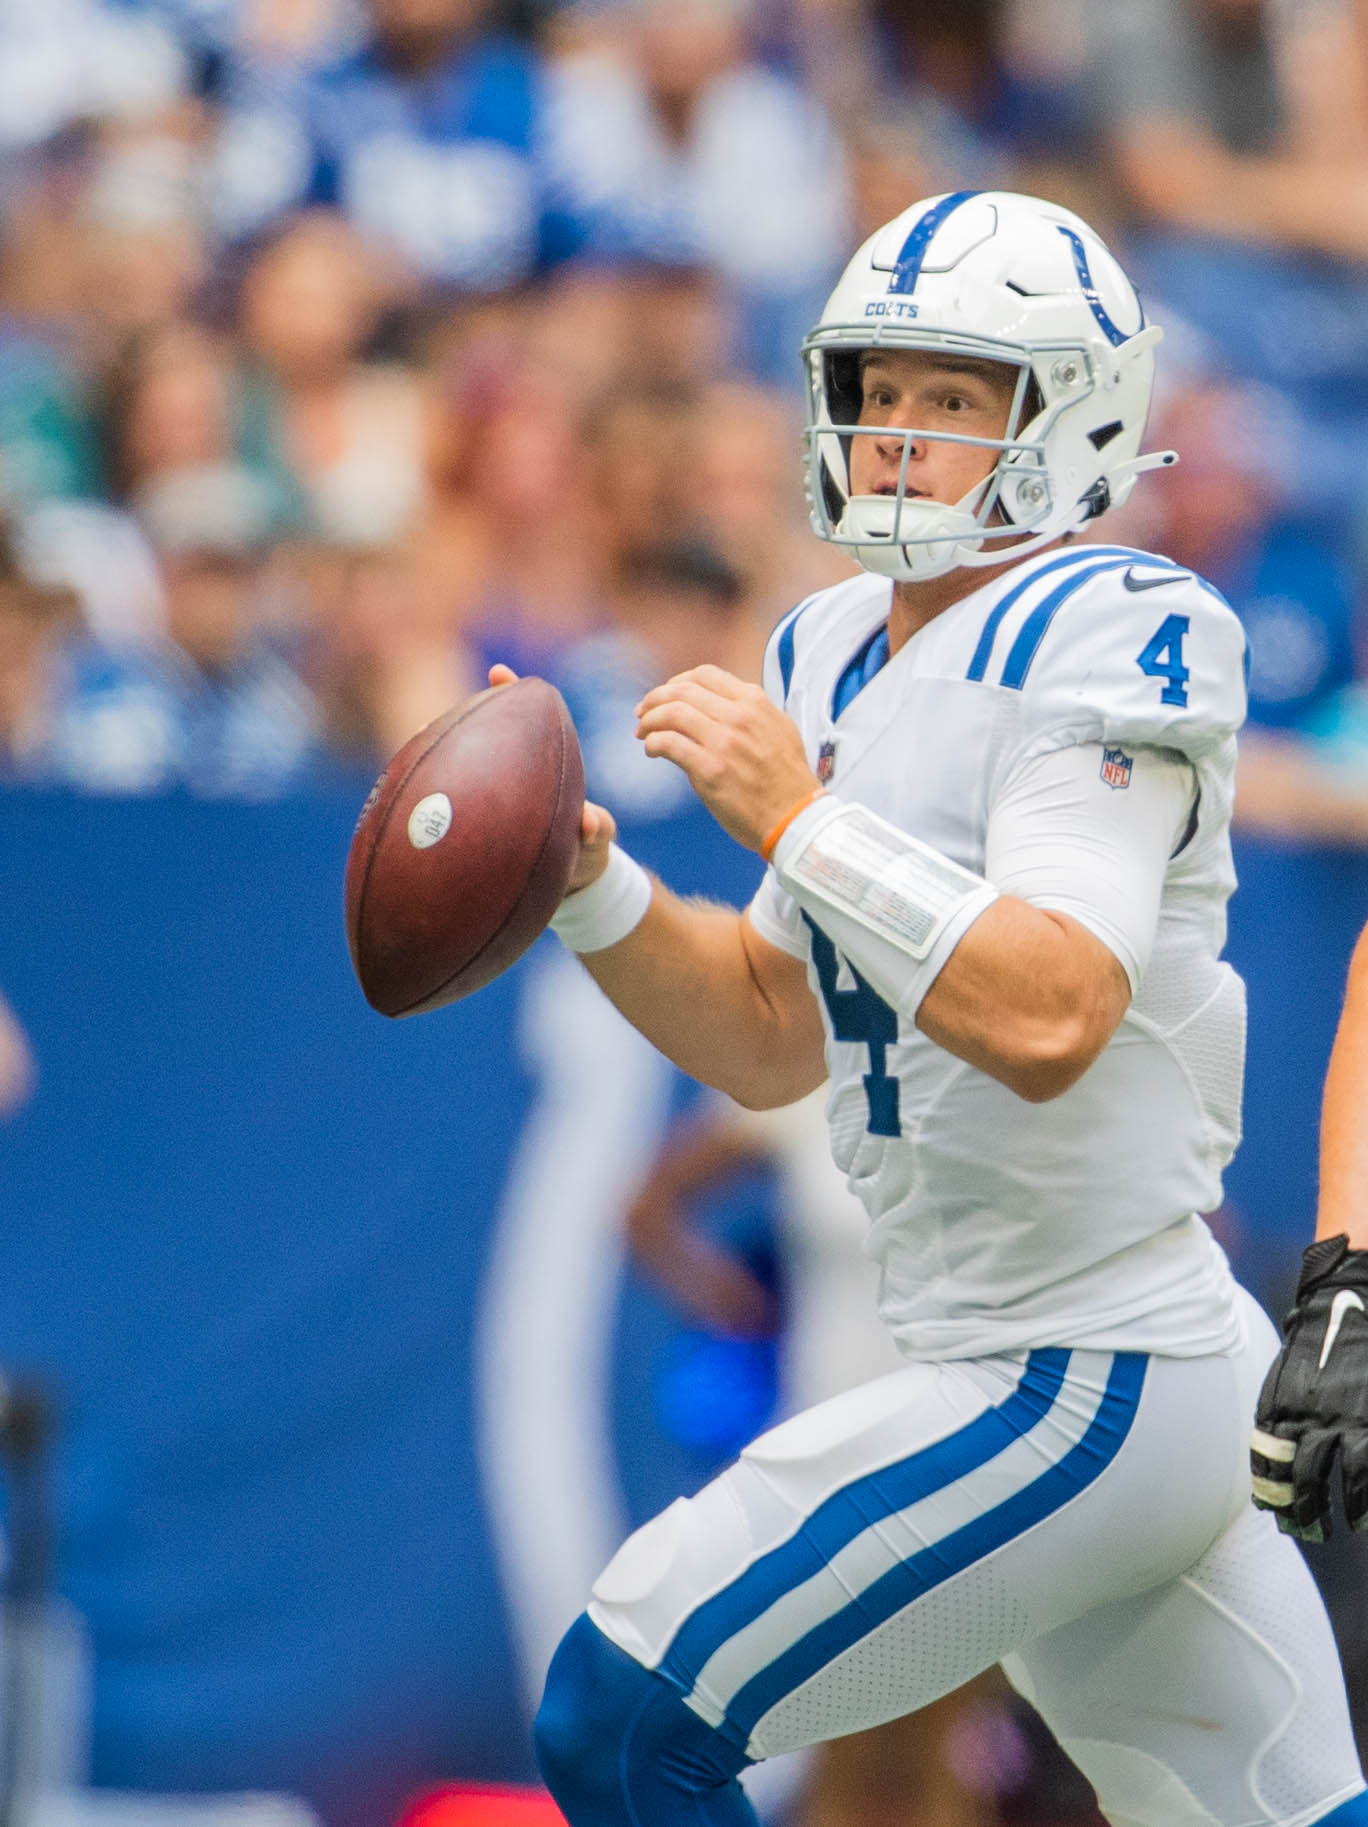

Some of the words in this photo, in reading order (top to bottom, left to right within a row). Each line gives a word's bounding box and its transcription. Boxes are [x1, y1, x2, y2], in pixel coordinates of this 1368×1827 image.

[1136, 613, 1190, 708] 4
[1103, 762, 1129, 786] NFL
[799, 906, 902, 1138] 4
